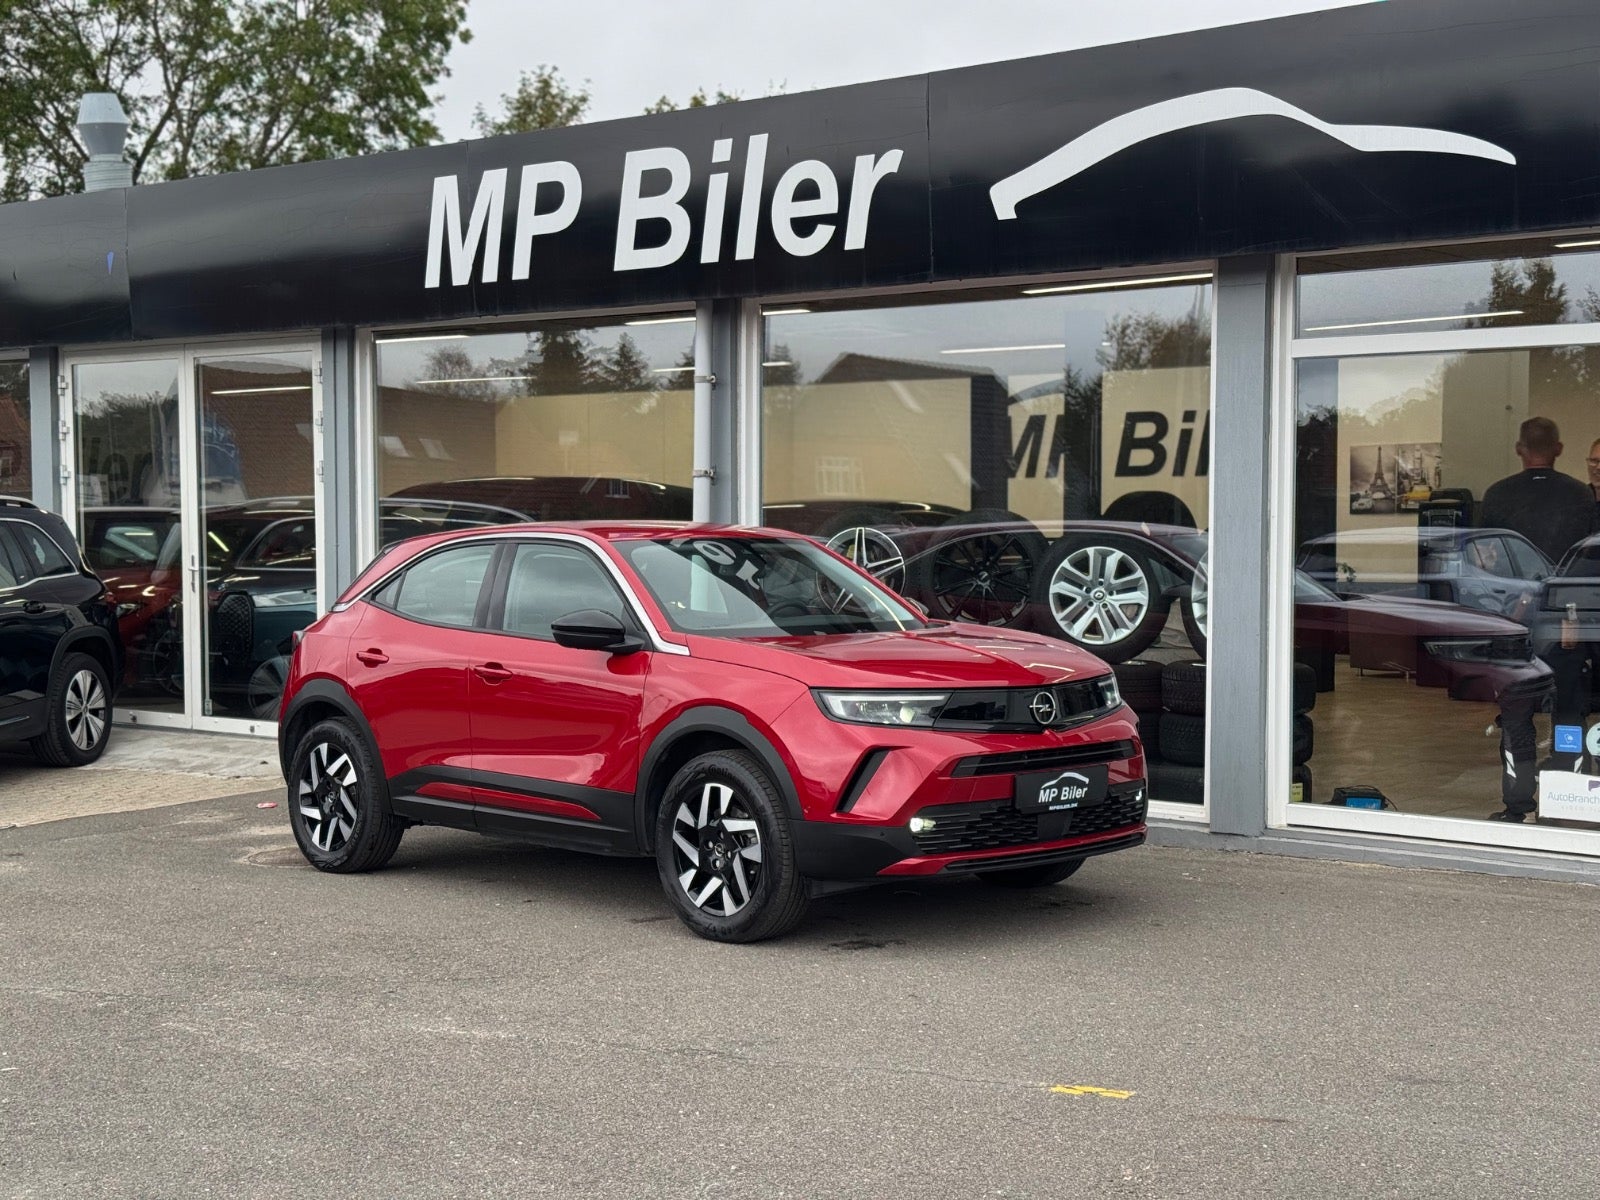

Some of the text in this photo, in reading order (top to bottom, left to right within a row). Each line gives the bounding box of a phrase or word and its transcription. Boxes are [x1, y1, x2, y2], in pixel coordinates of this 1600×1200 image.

[424, 133, 904, 289] MP Biler
[1038, 785, 1088, 803] MP Biler
